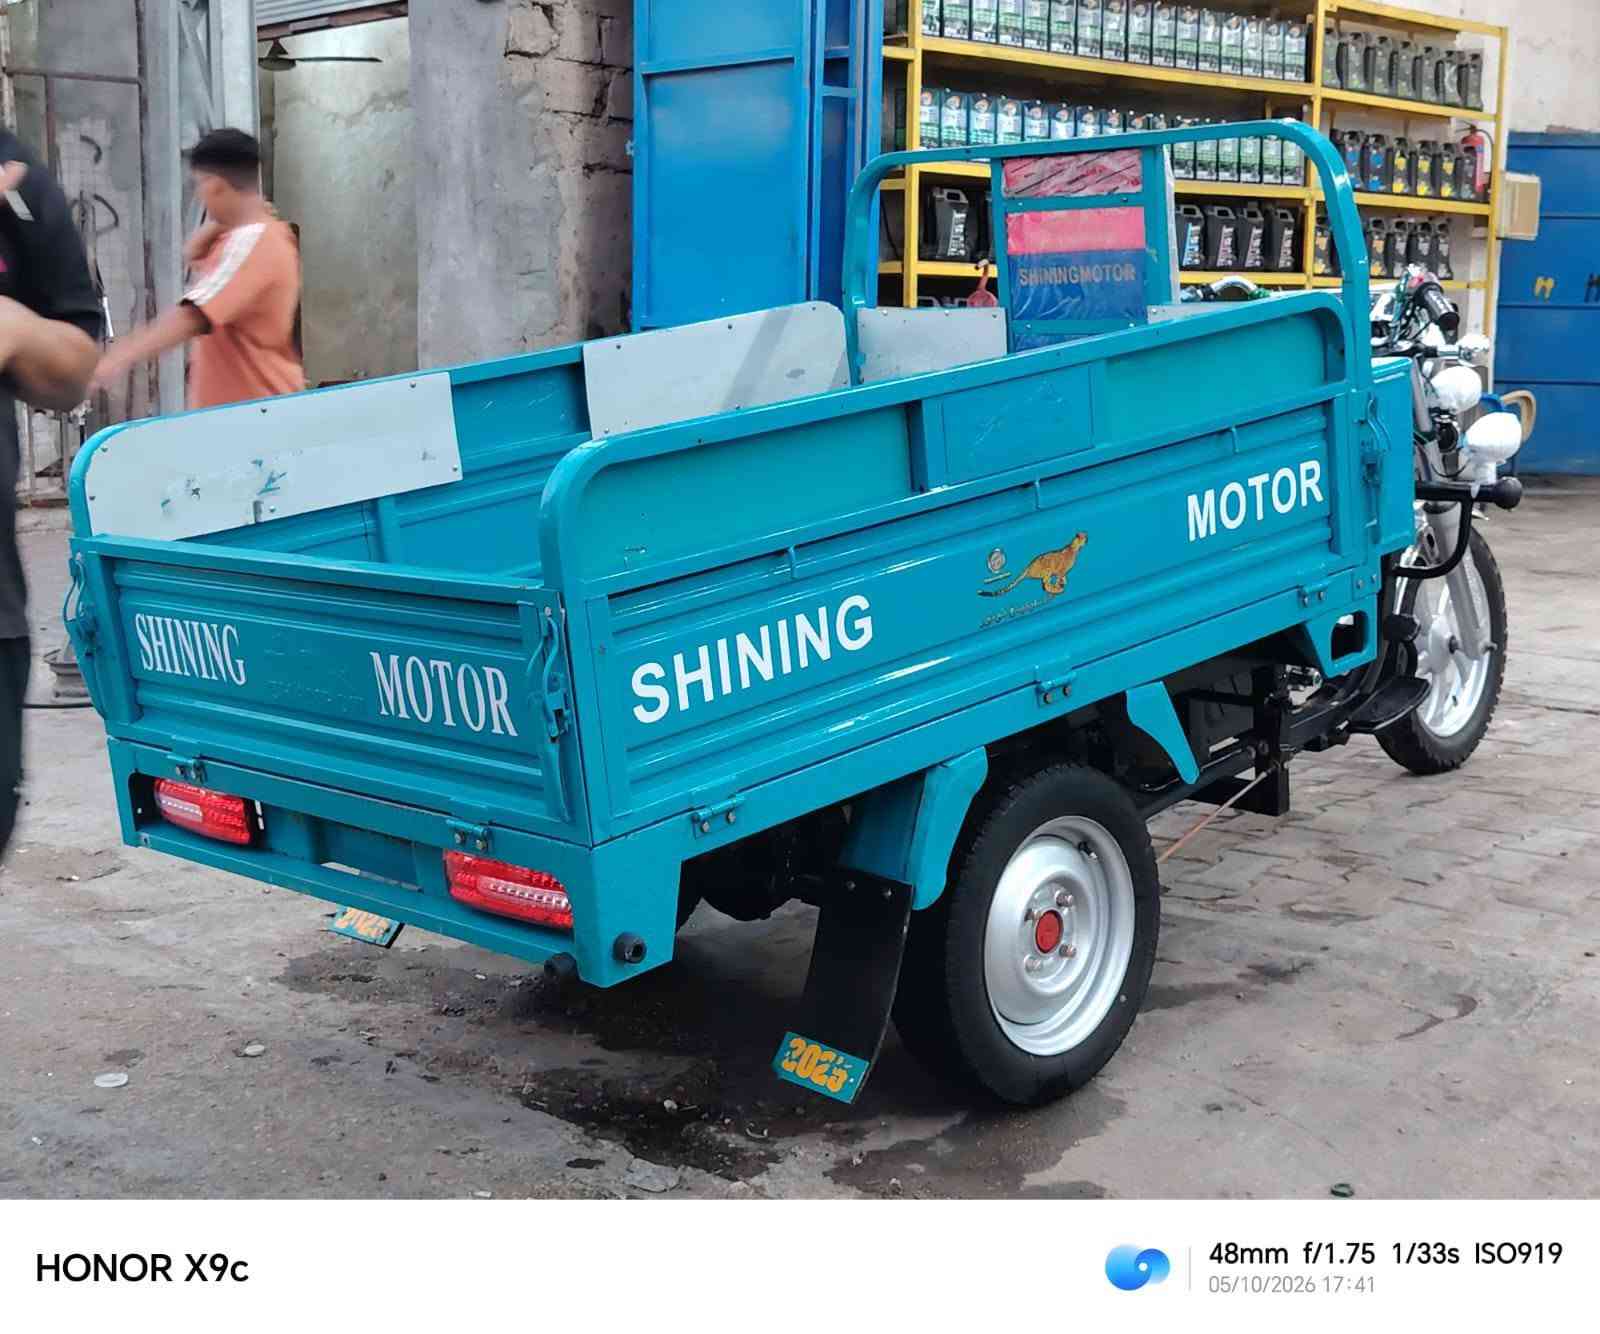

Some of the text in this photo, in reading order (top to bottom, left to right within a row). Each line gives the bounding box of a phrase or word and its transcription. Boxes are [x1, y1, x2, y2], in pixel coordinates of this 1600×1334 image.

[1187, 459, 1324, 542] MOTOR
[135, 612, 247, 686] SHINING
[369, 651, 519, 737] MOTOR
[631, 594, 874, 724] SHINING
[781, 1037, 849, 1093] 2025
